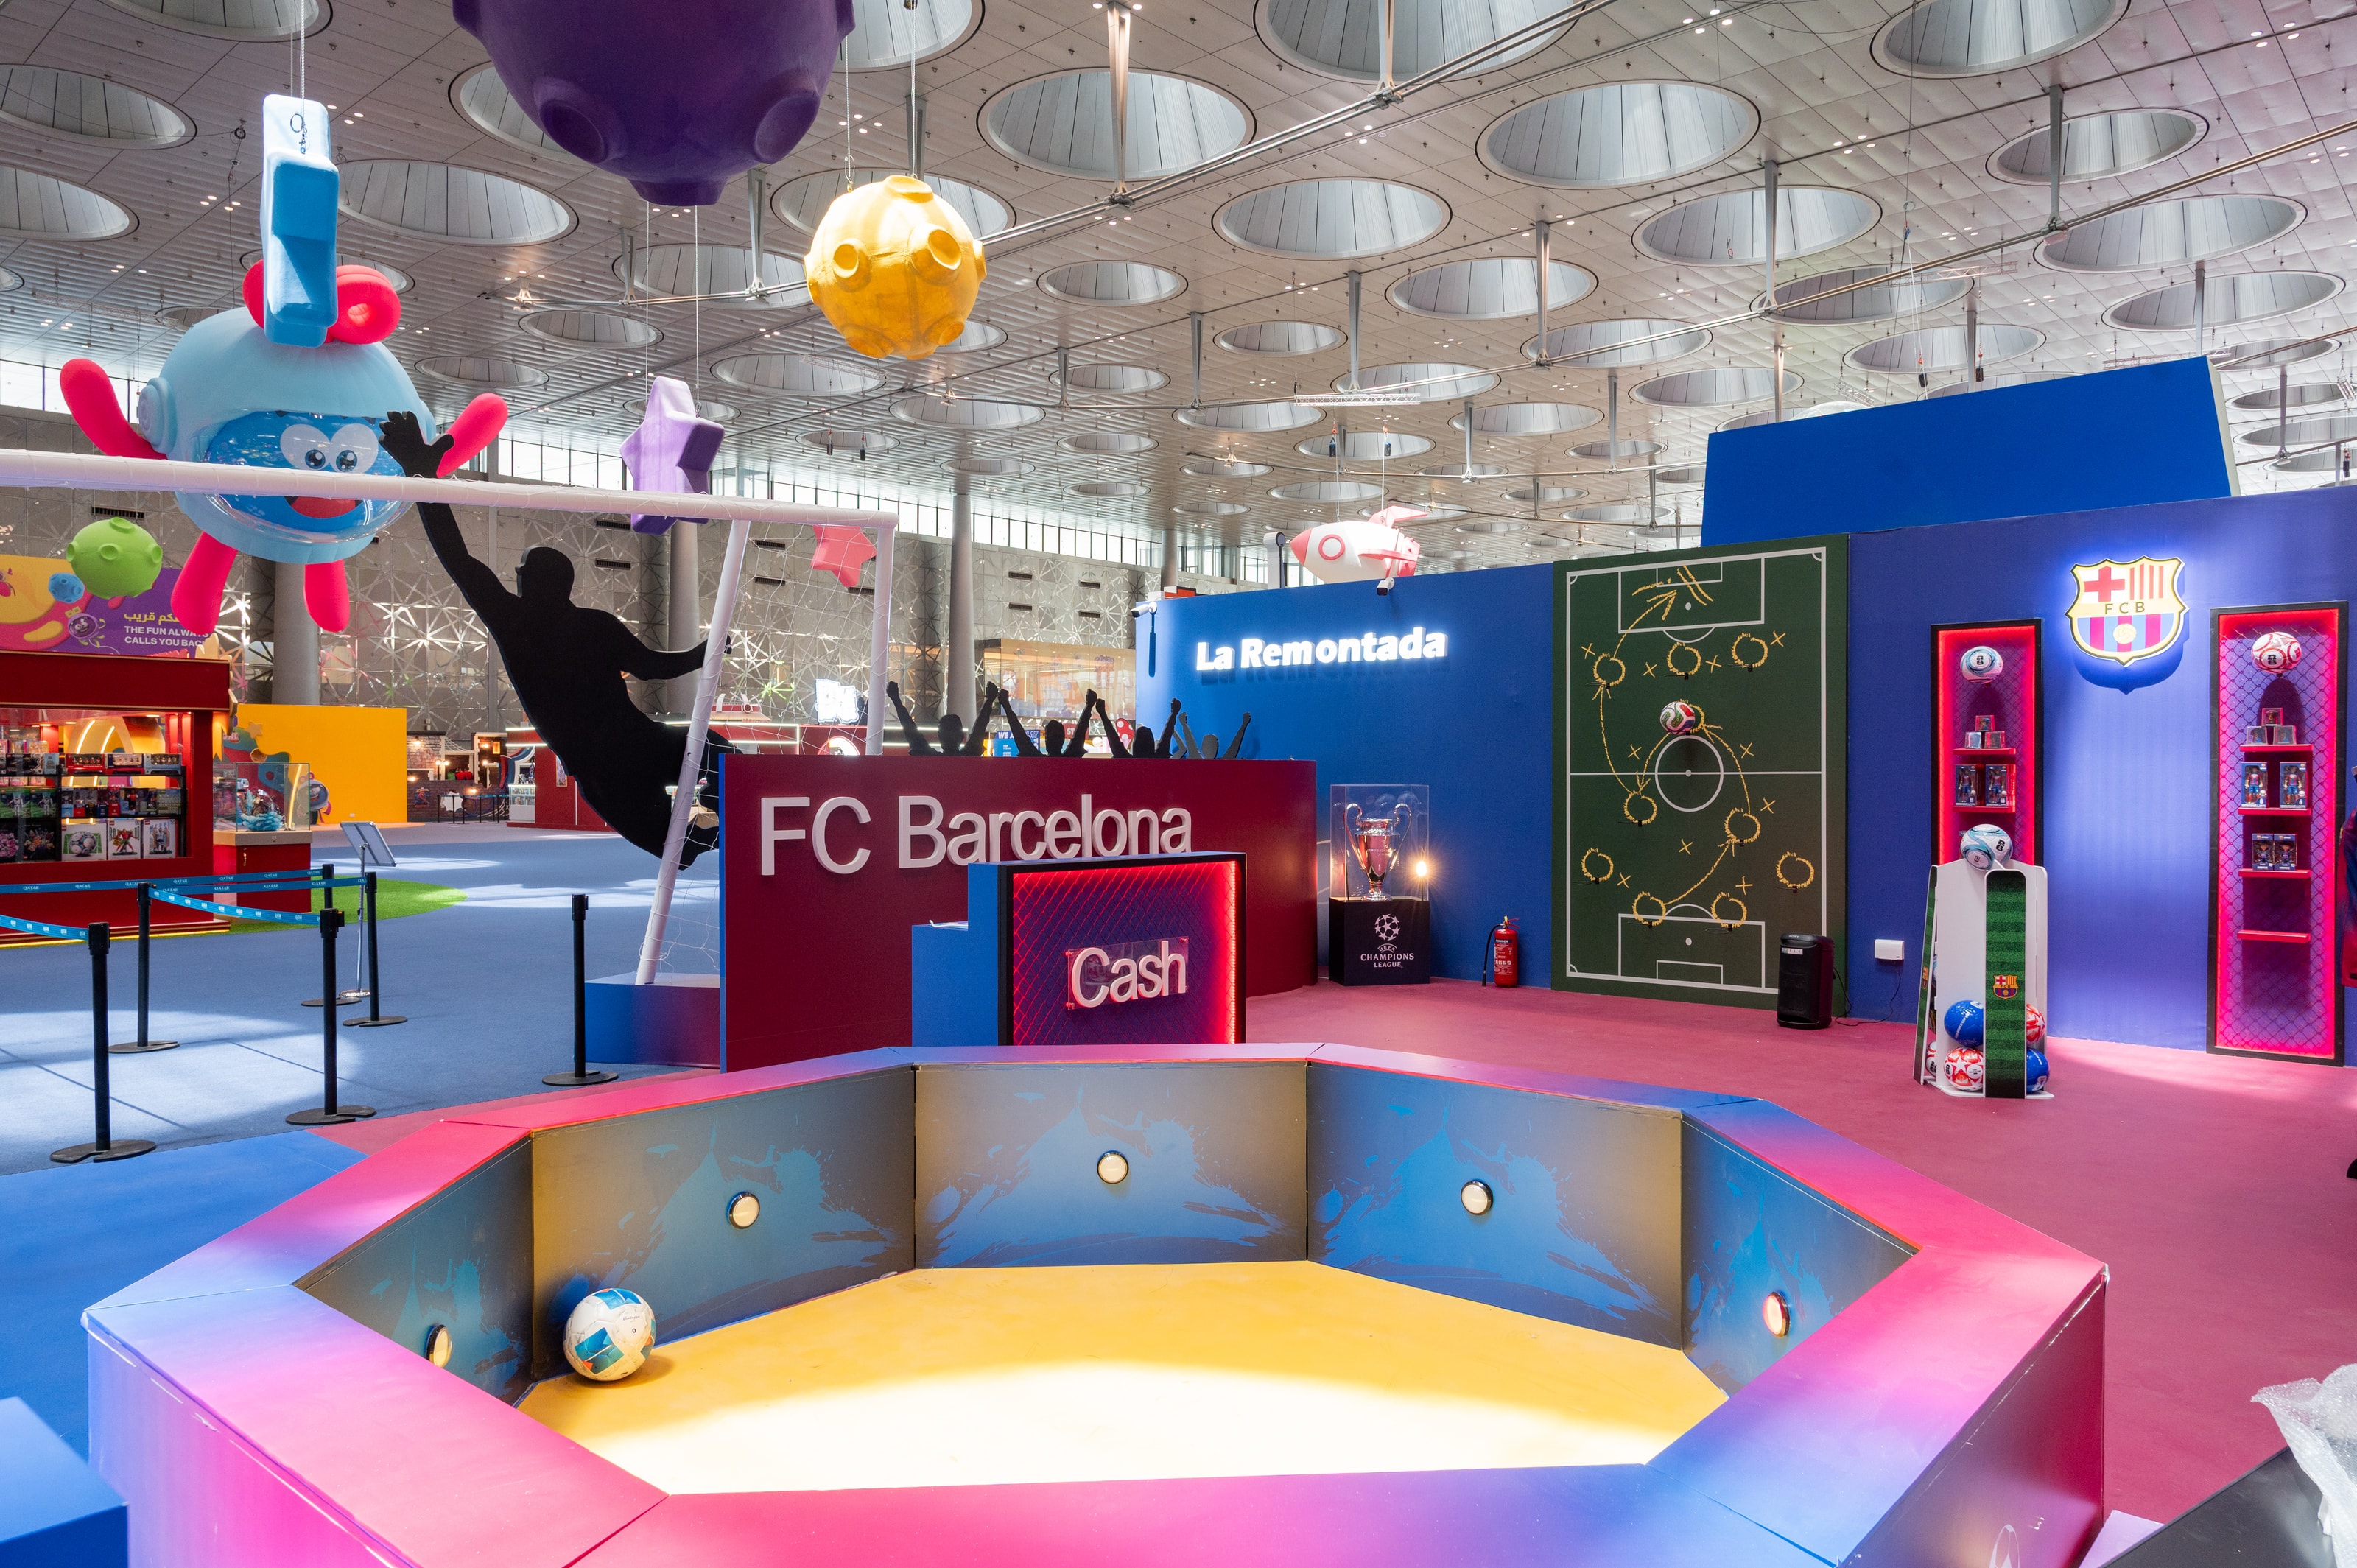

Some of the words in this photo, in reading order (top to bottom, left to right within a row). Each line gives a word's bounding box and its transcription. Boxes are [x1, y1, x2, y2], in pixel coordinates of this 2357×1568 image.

[2104, 602, 2145, 614] FCB
[124, 625, 144, 634] THE
[146, 627, 166, 635] FUN
[168, 628, 209, 638] ALWAS
[124, 636, 158, 644] CALLS
[158, 638, 180, 646] YOU
[1196, 641, 1235, 671] La
[1240, 626, 1448, 669] Remontada
[998, 731, 1009, 739] WE
[760, 796, 871, 876] FC
[898, 793, 1192, 867] Barcelona
[1360, 953, 1414, 961] CHAMPIONS
[1071, 940, 1187, 1008] Cash
